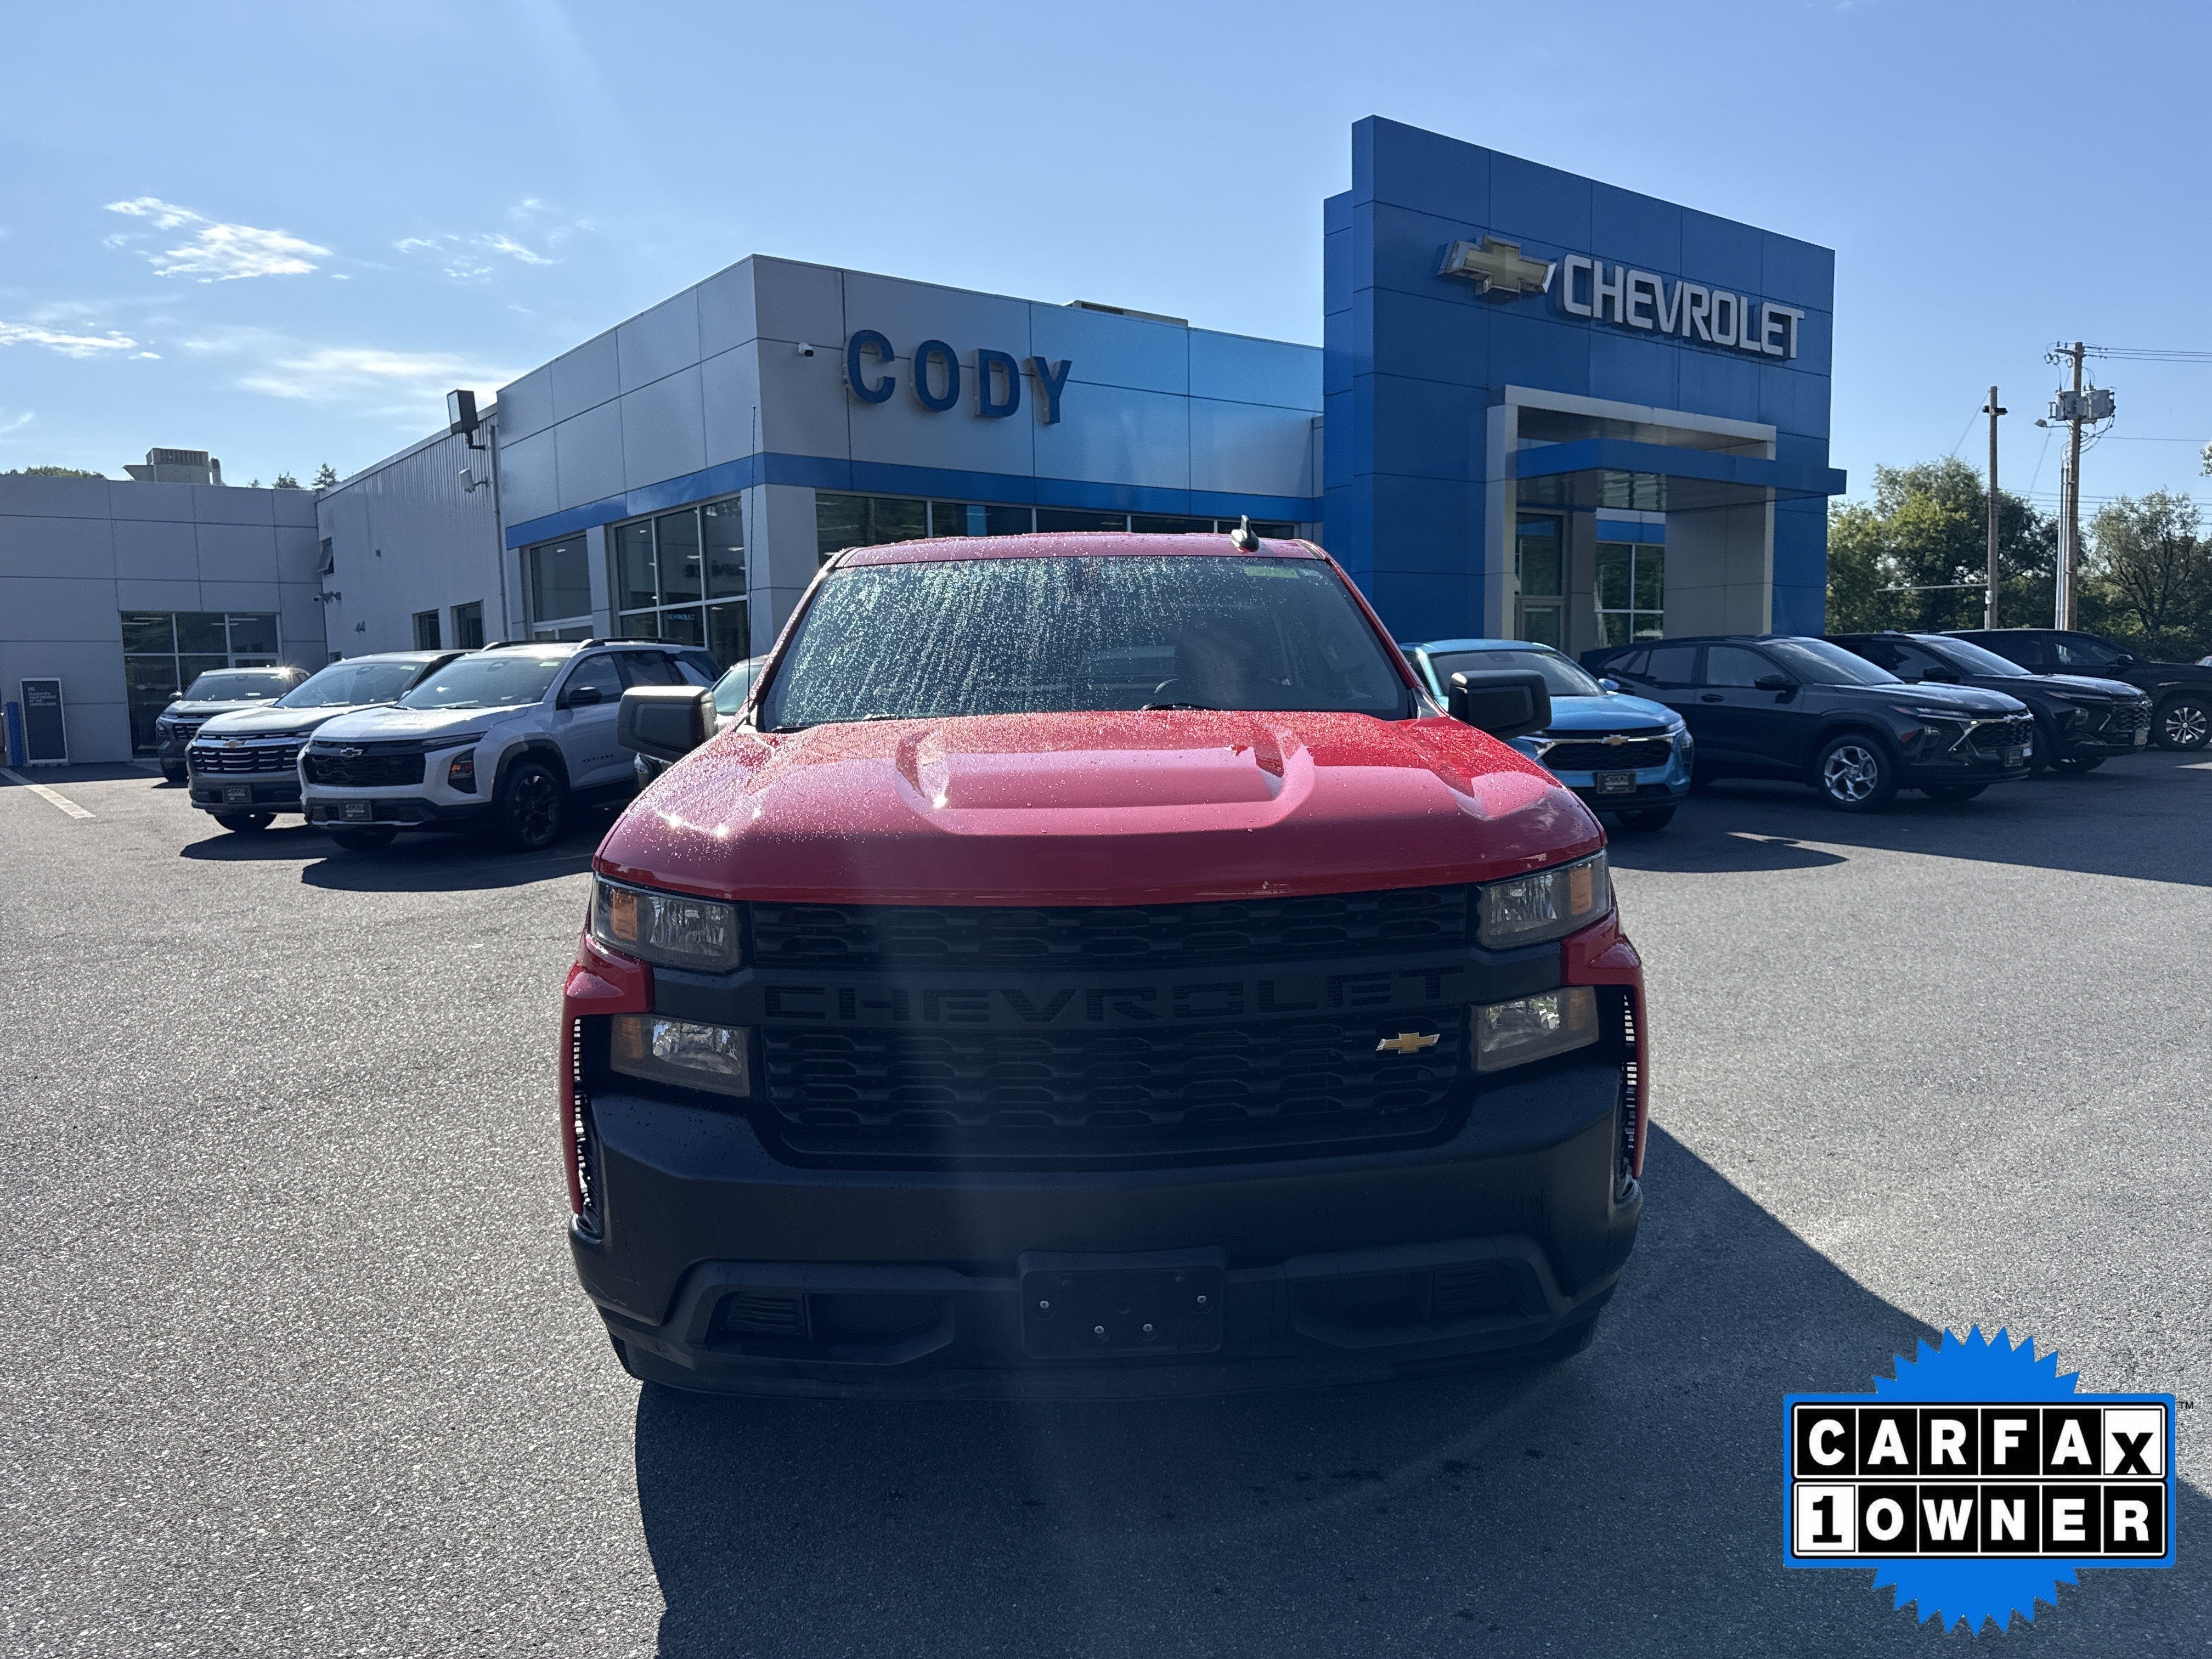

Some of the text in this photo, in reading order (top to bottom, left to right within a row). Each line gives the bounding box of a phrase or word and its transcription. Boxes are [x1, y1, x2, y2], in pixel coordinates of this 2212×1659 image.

[1564, 253, 1805, 359] CHEVROLET
[843, 329, 1073, 425] CODY
[764, 964, 1464, 1023] CHEVROLET
